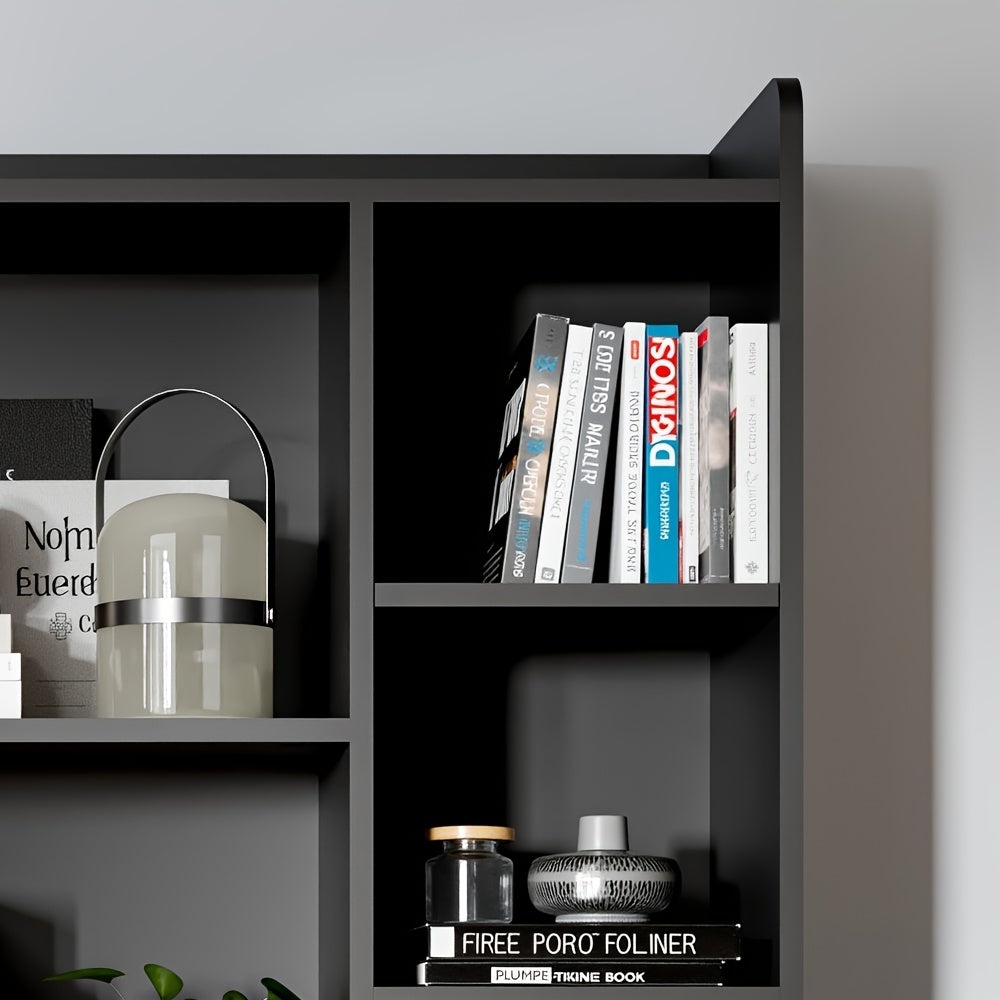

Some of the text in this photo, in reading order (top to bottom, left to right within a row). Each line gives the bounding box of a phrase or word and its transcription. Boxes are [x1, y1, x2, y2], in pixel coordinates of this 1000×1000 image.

[462, 932, 521, 955] FIREE
[496, 969, 549, 981] PLUMPE
[605, 972, 646, 983] BOOK
